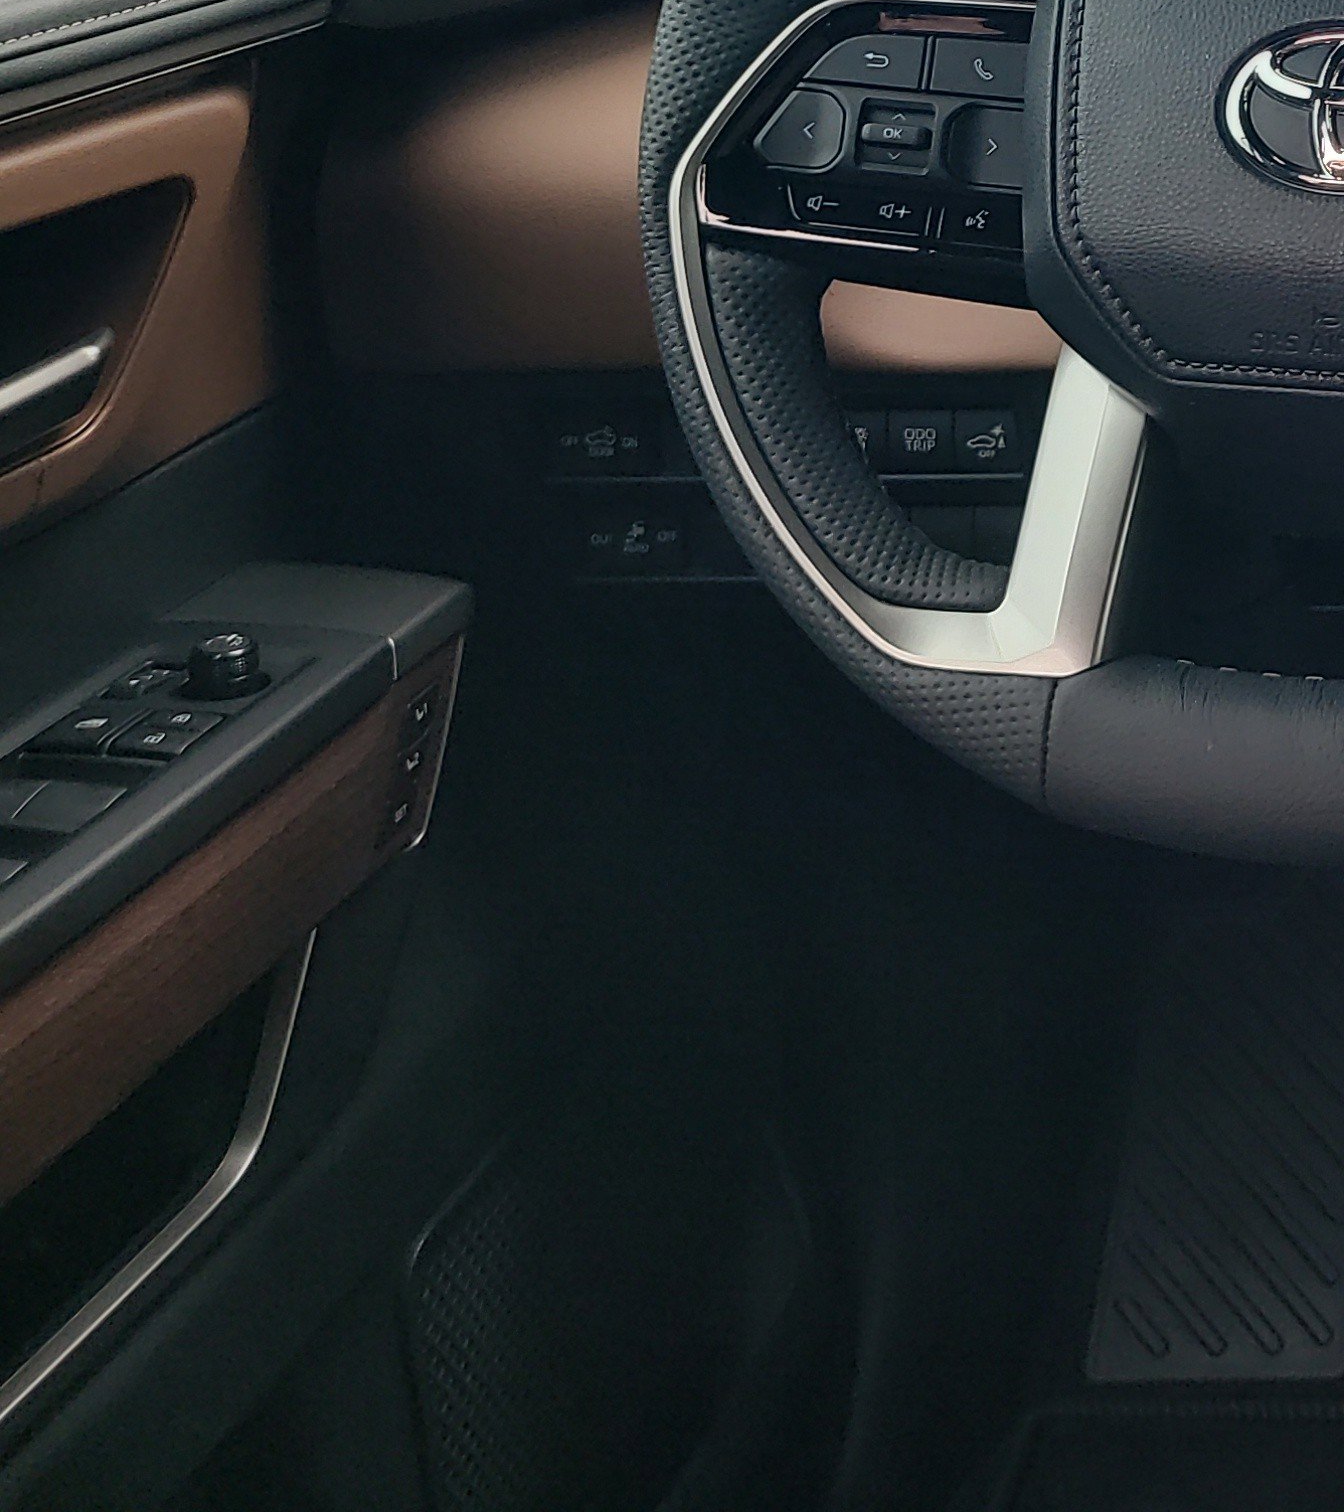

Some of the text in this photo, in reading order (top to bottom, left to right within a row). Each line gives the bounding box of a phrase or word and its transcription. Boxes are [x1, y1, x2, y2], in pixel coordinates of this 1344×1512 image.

[883, 128, 902, 139] OK
[904, 428, 936, 439] ODO
[904, 440, 936, 452] TRIP
